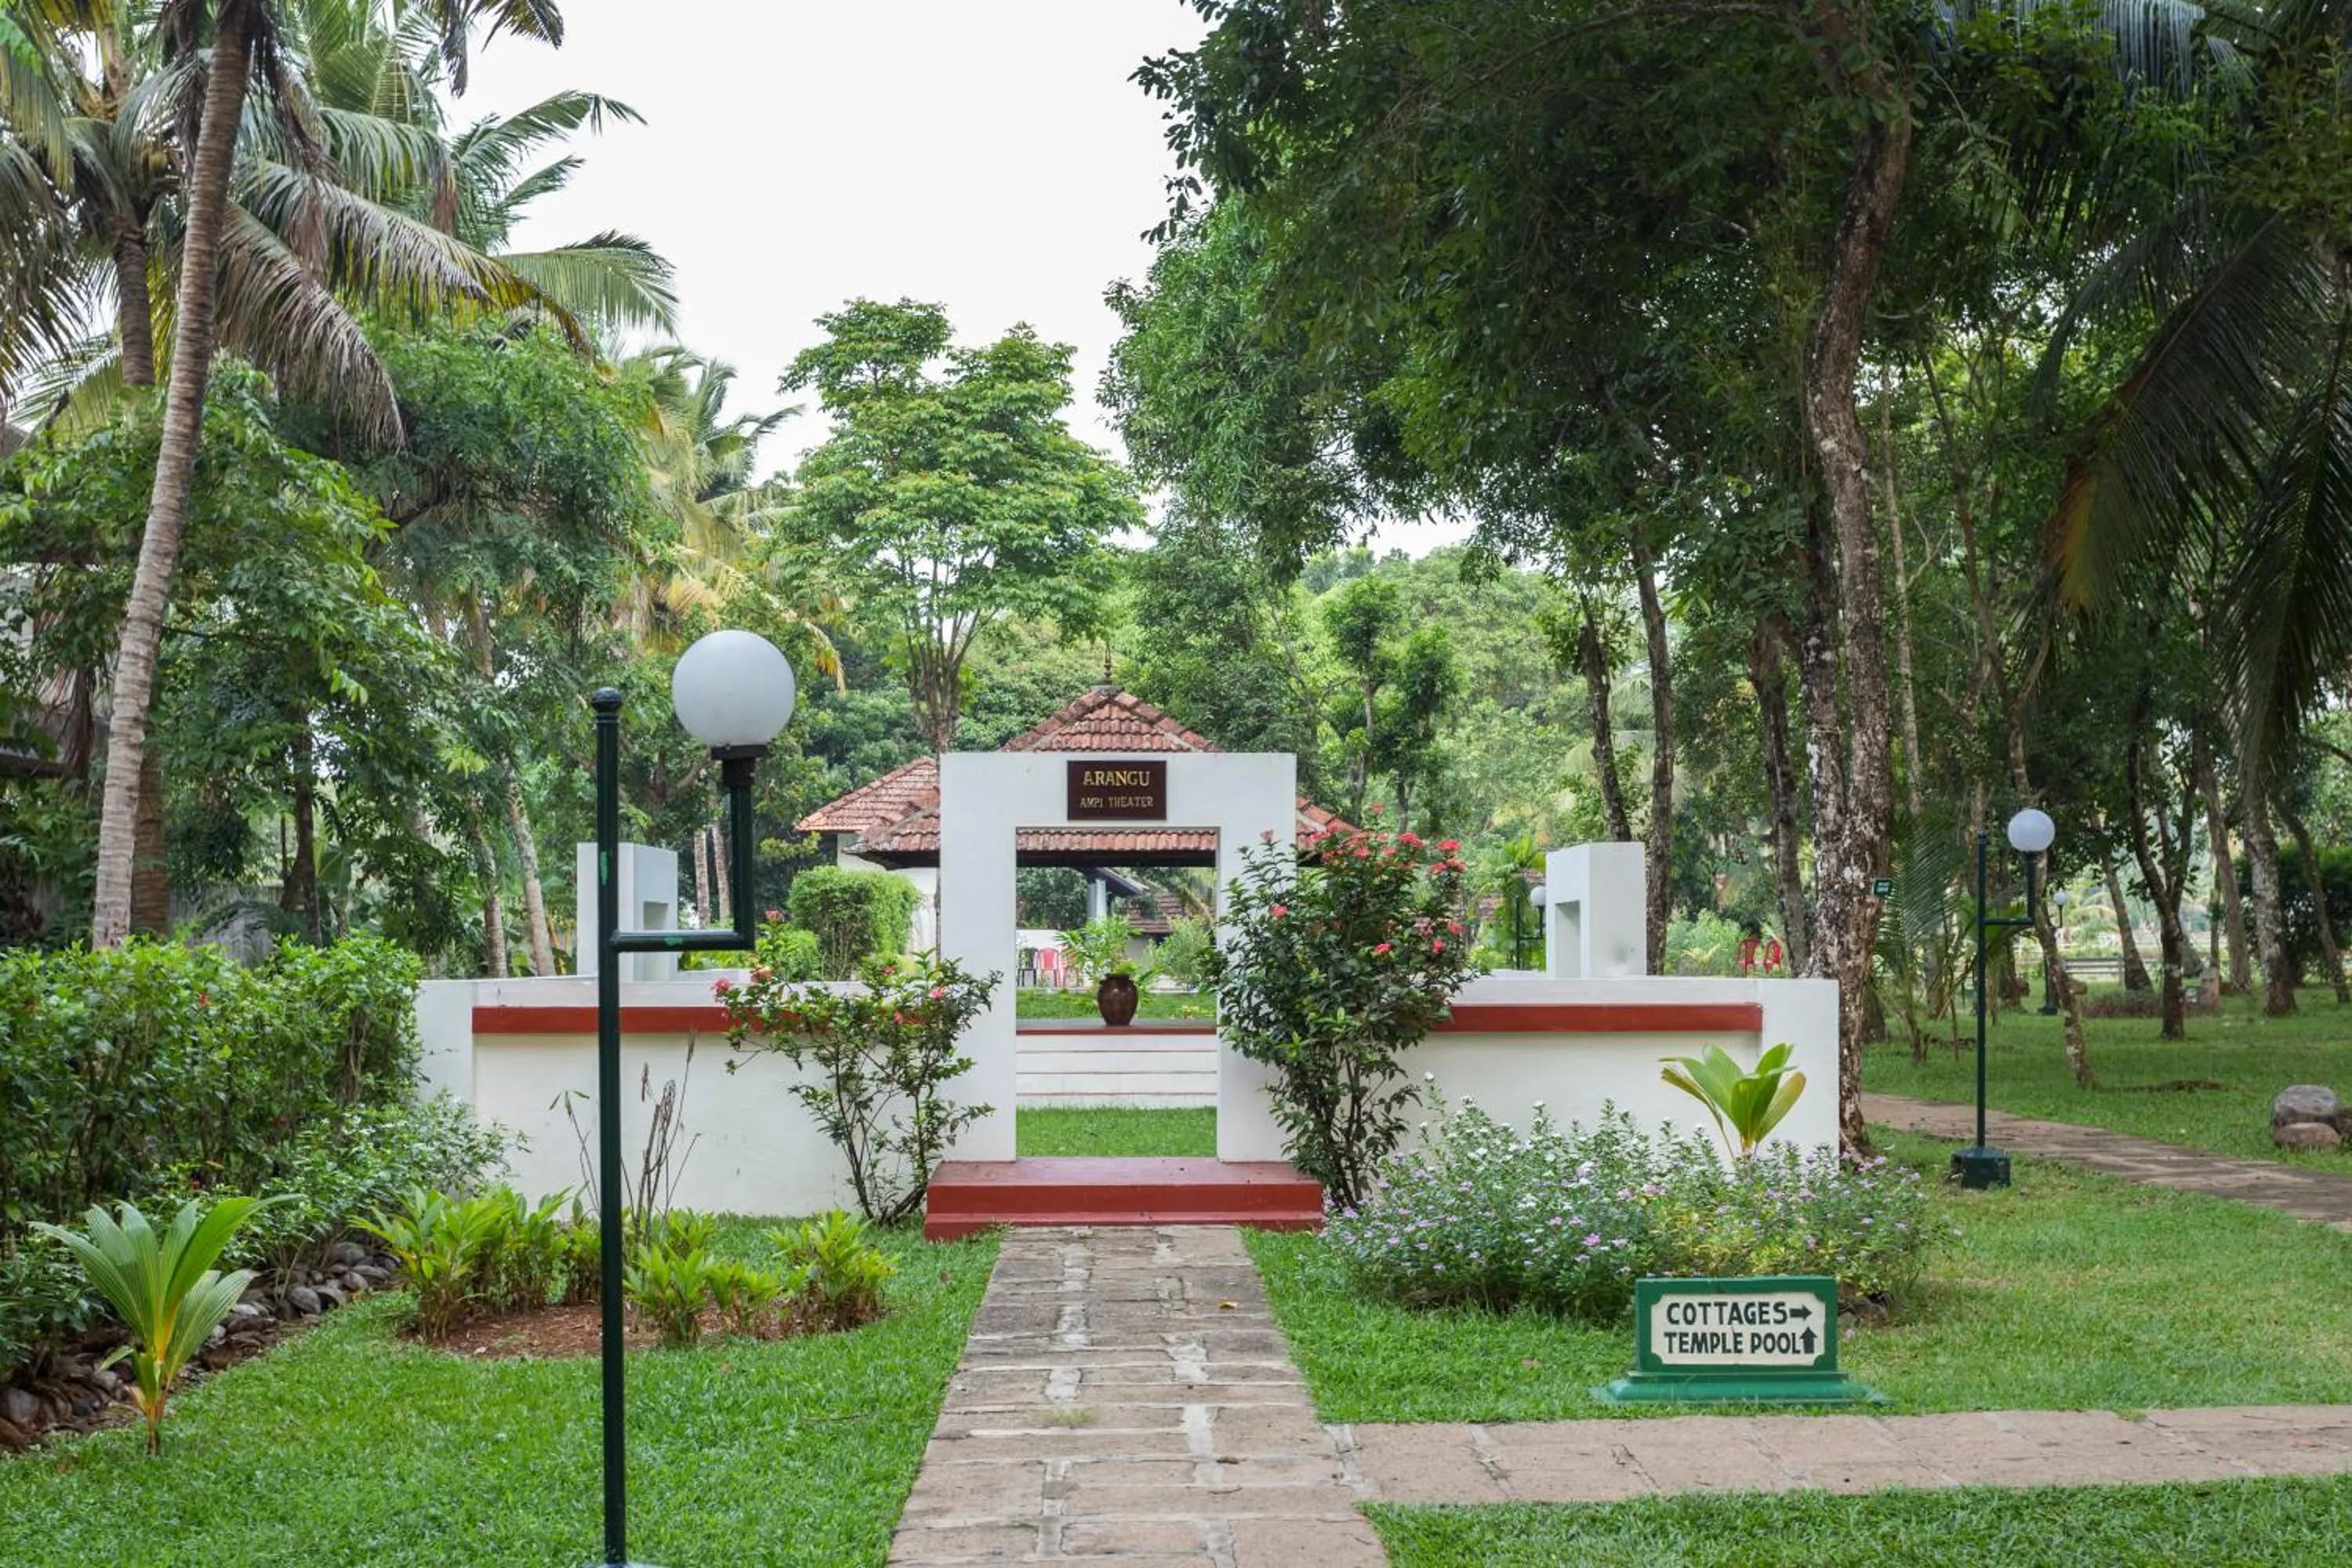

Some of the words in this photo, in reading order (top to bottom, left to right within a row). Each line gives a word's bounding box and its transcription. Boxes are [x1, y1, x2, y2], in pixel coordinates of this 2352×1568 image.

[1083, 771, 1150, 786] ARANGU
[1109, 796, 1154, 808] THEATER
[1666, 1301, 1788, 1326] COTTAGES
[1664, 1332, 1743, 1355] TEMPLE
[1751, 1332, 1801, 1355] POOL
